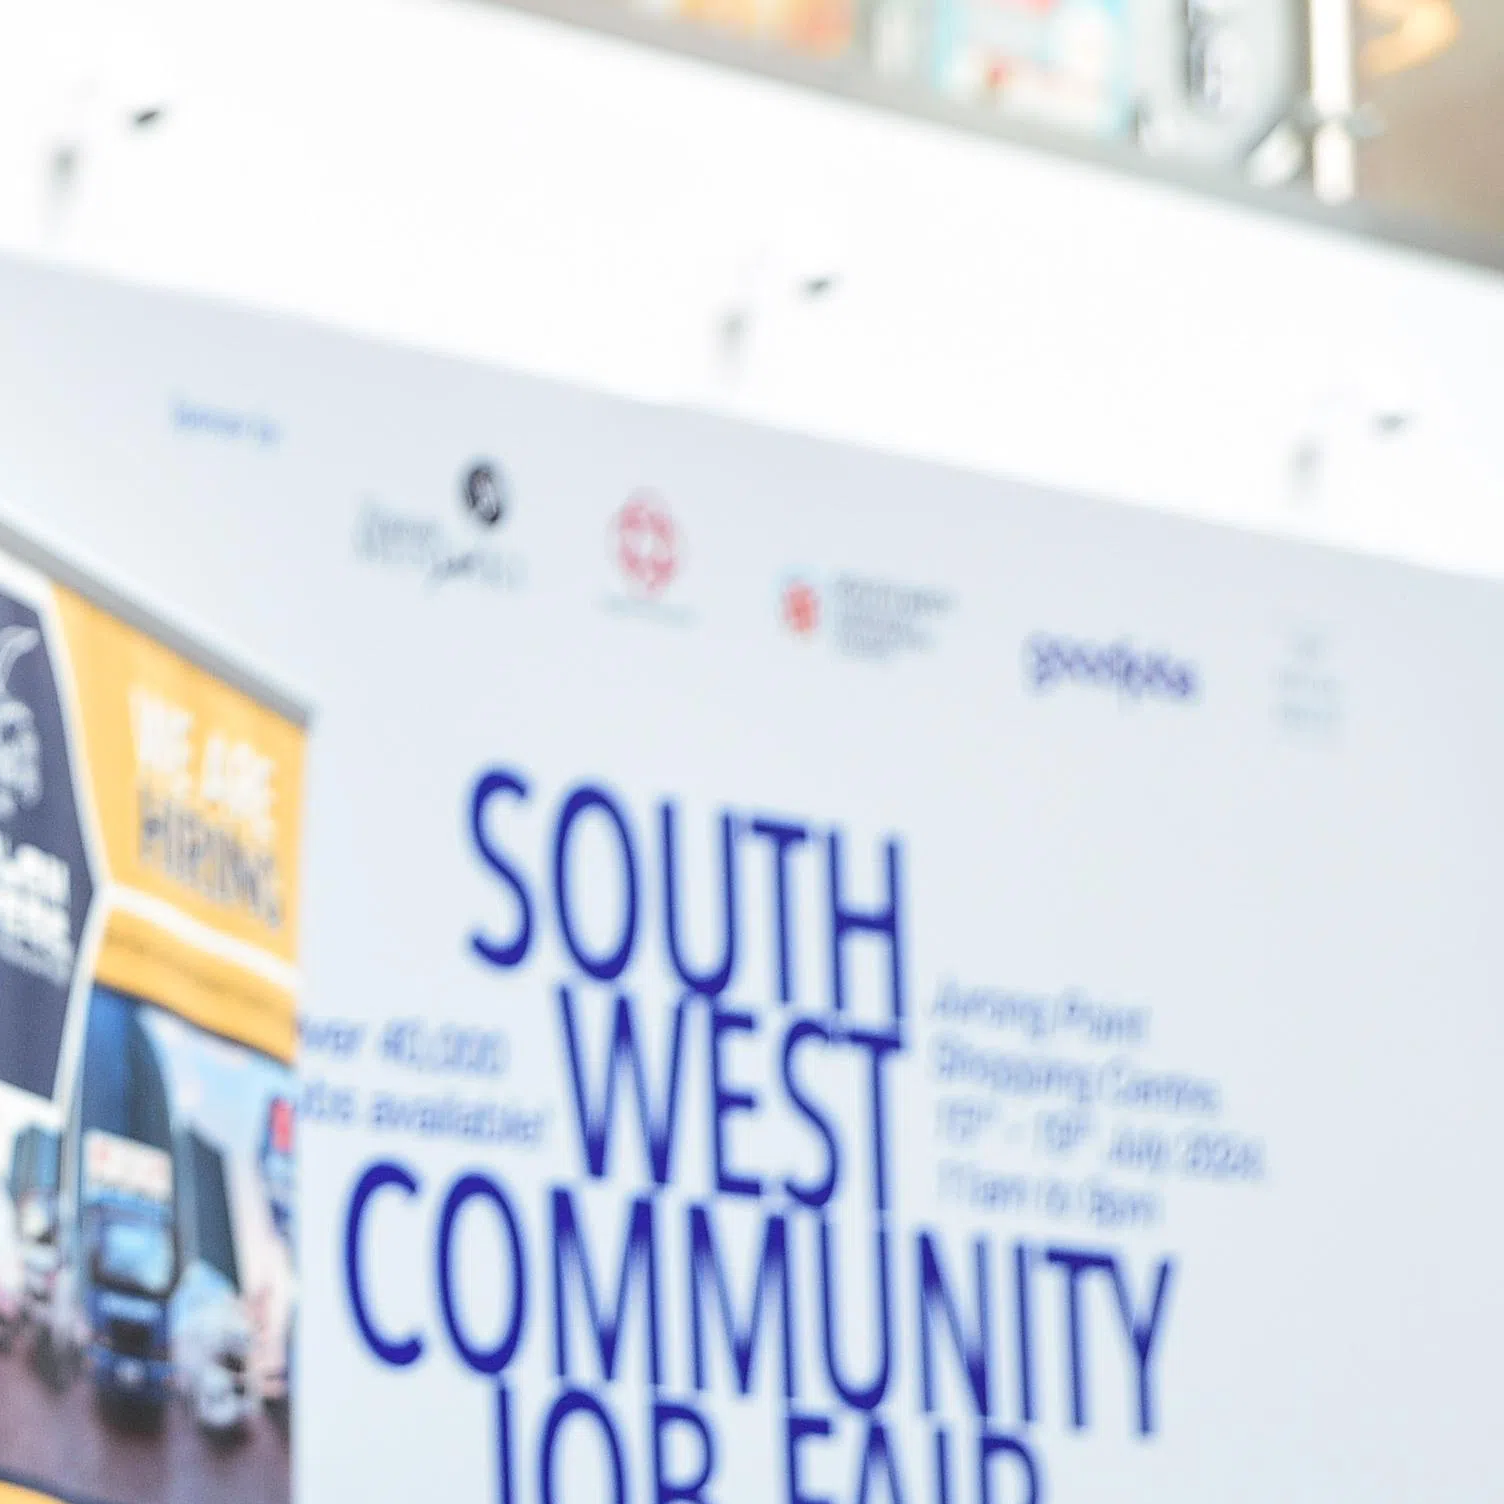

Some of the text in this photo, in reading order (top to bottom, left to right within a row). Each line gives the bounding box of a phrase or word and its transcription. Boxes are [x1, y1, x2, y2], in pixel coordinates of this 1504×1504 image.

[468, 770, 905, 1020] SOUTH
[558, 986, 904, 1210] WEST
[346, 1160, 1173, 1437] COMMUNITY
